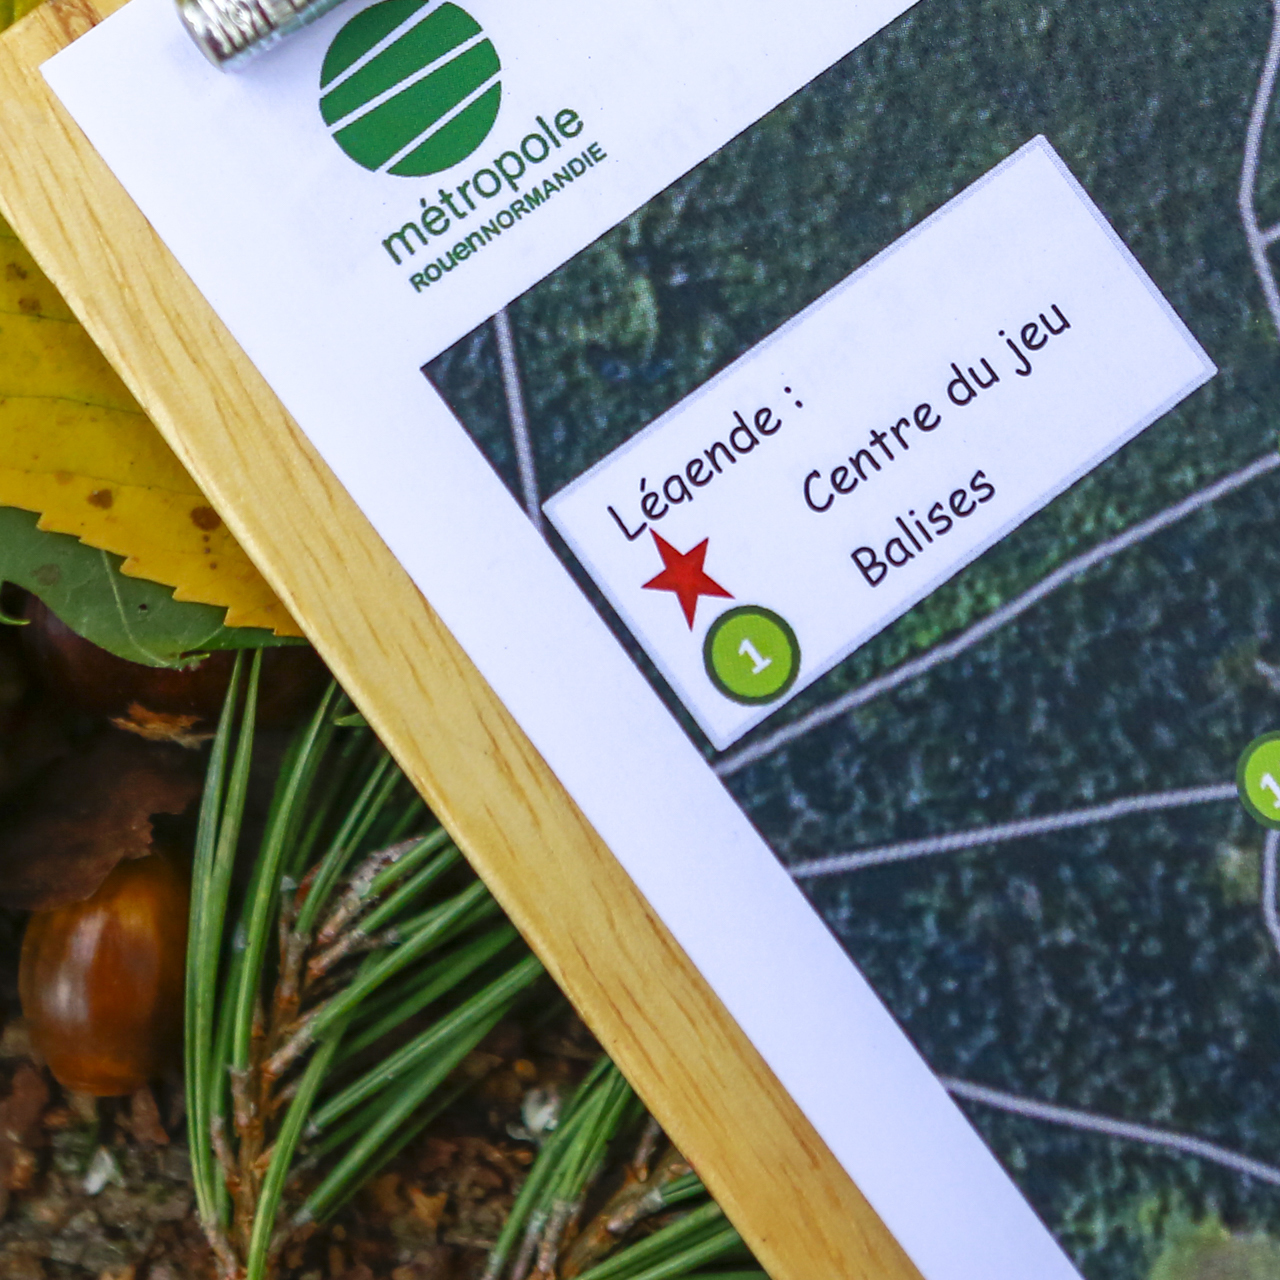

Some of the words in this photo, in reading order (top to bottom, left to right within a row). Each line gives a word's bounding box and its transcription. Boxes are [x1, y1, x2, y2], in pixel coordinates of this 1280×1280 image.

[381, 107, 584, 265] métropole
[802, 402, 942, 514] Centre
[945, 355, 1000, 406] du
[998, 303, 1071, 377] jeu
[850, 469, 996, 588] Balises
[737, 637, 773, 675] 1
